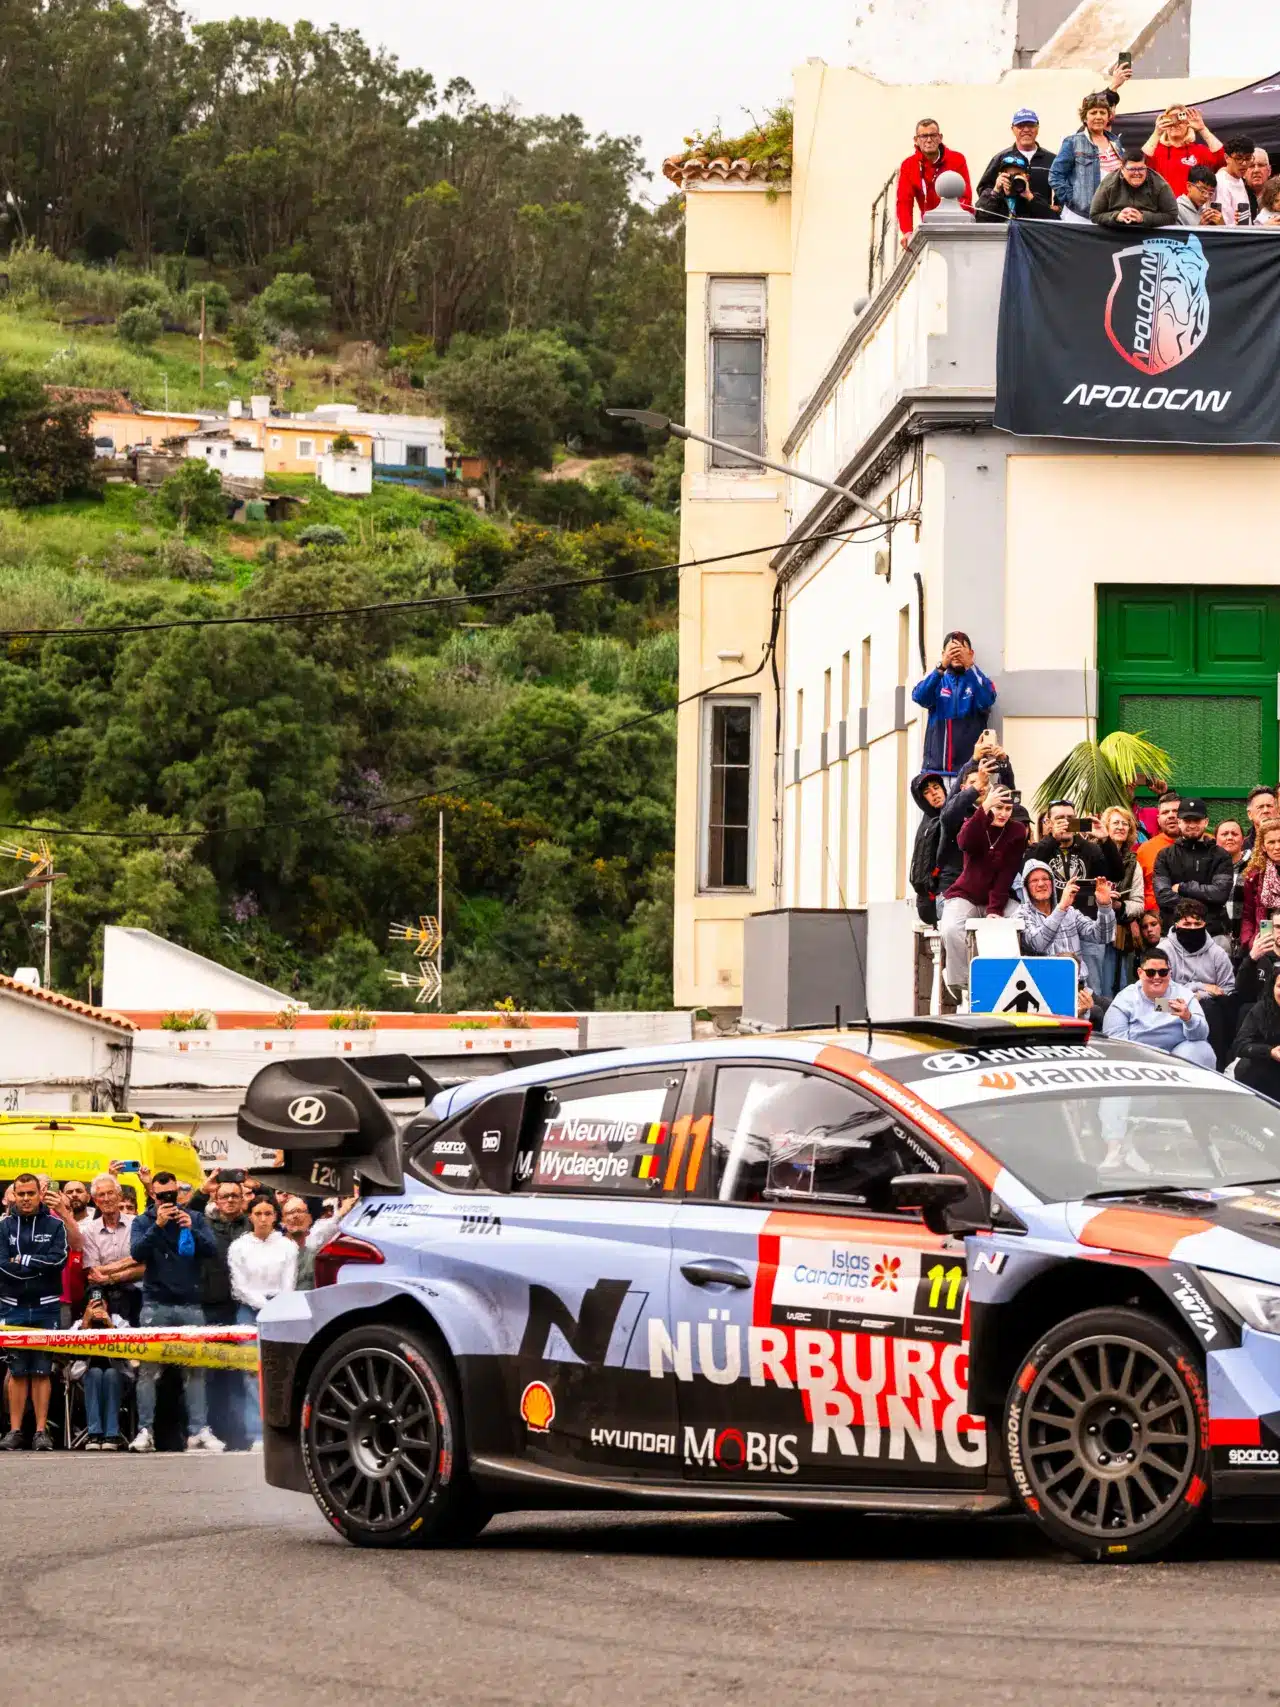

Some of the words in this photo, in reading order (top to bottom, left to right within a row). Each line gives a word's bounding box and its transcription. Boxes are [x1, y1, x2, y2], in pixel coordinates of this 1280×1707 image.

[1131, 249, 1160, 363] APOLOCAN
[1063, 383, 1233, 412] APOLOCAN
[977, 1046, 1107, 1064] HYUNDAI
[432, 1141, 467, 1154] sparco
[543, 1119, 553, 1141] T.
[560, 1119, 638, 1143] Neuville
[515, 1153, 534, 1175] M.
[539, 1151, 629, 1181] Wydaeghe
[663, 1114, 713, 1192] 11
[907, 1137, 941, 1173] HYUNDAI
[794, 1264, 870, 1289] Canarias
[832, 1250, 870, 1271] Islas
[927, 1264, 962, 1310] 11
[1173, 1272, 1214, 1316] HYUNDAI
[1173, 1288, 1218, 1342] WIA
[647, 1308, 970, 1403] NÜRBURG
[810, 1387, 987, 1468] RING
[590, 1428, 676, 1454] HYUNDAI
[683, 1426, 799, 1475] MOBIS
[1229, 1449, 1279, 1464] sparco
